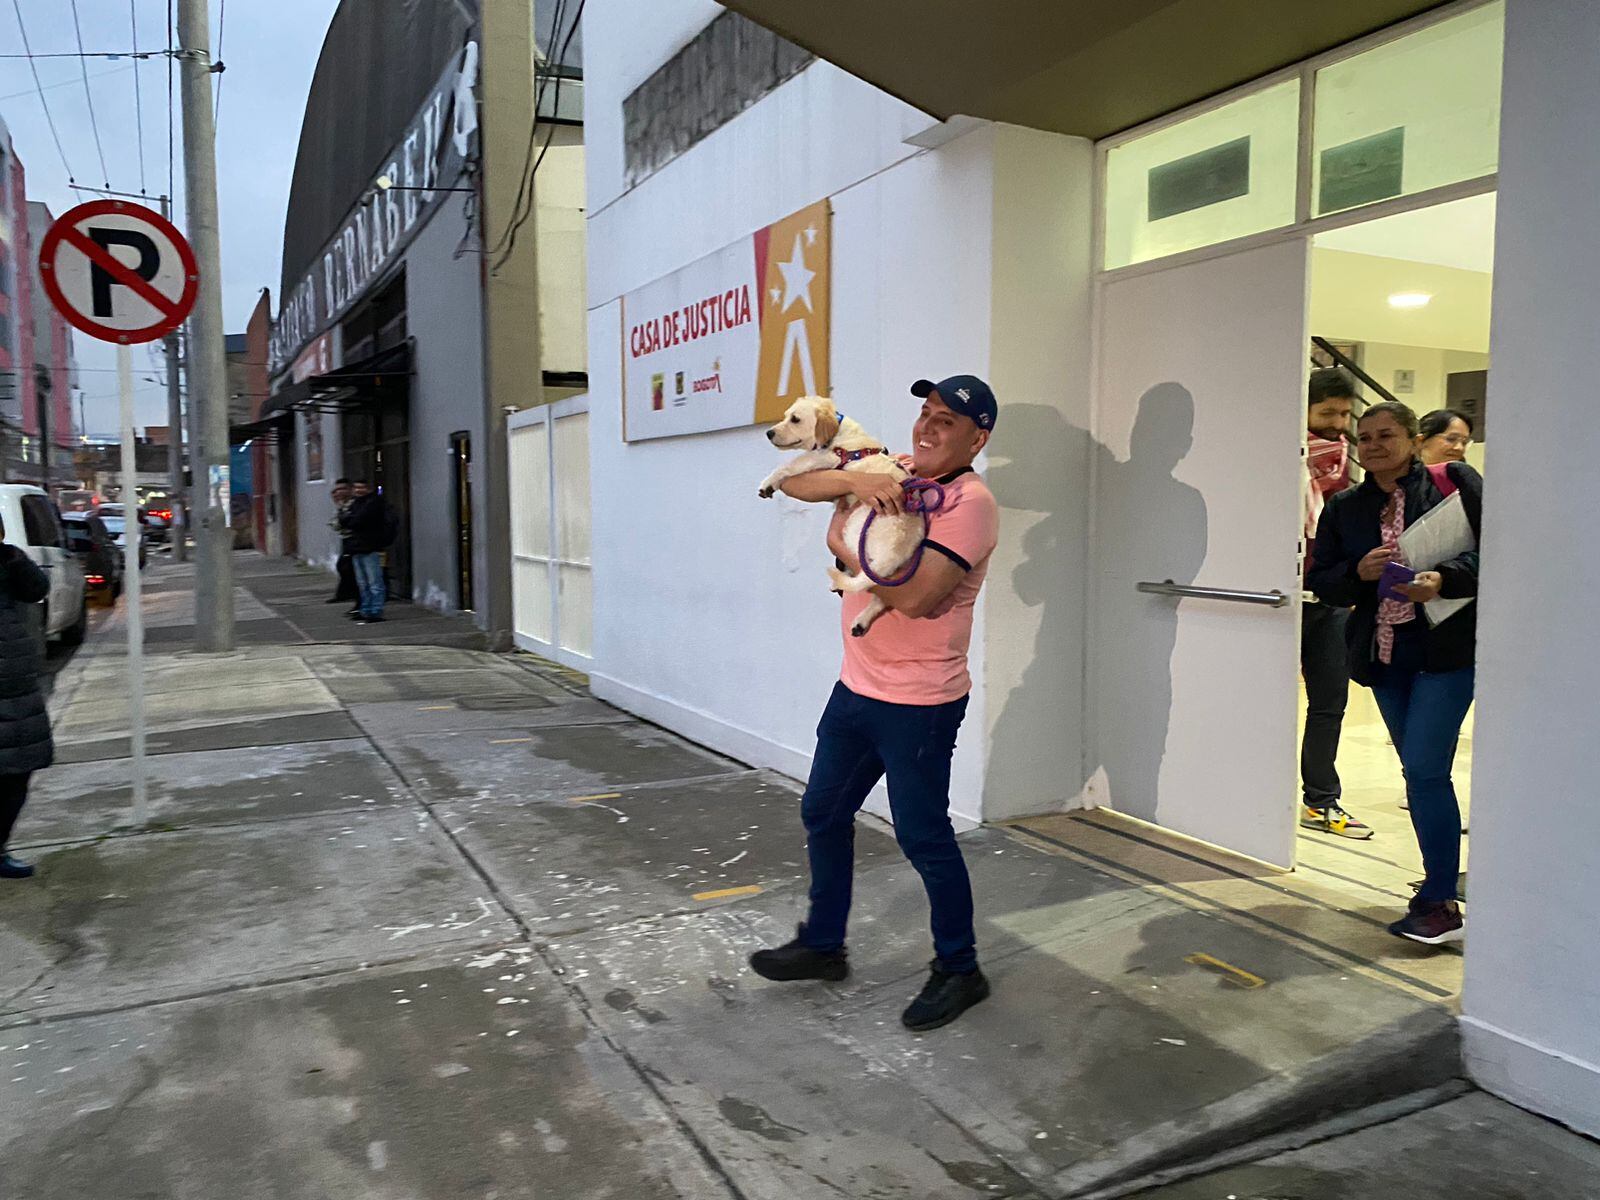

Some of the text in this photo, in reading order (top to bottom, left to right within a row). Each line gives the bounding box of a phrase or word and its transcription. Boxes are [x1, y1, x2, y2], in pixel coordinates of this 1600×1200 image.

[88, 227, 160, 317] P
[631, 284, 751, 358] CASA DE JUSTICIA
